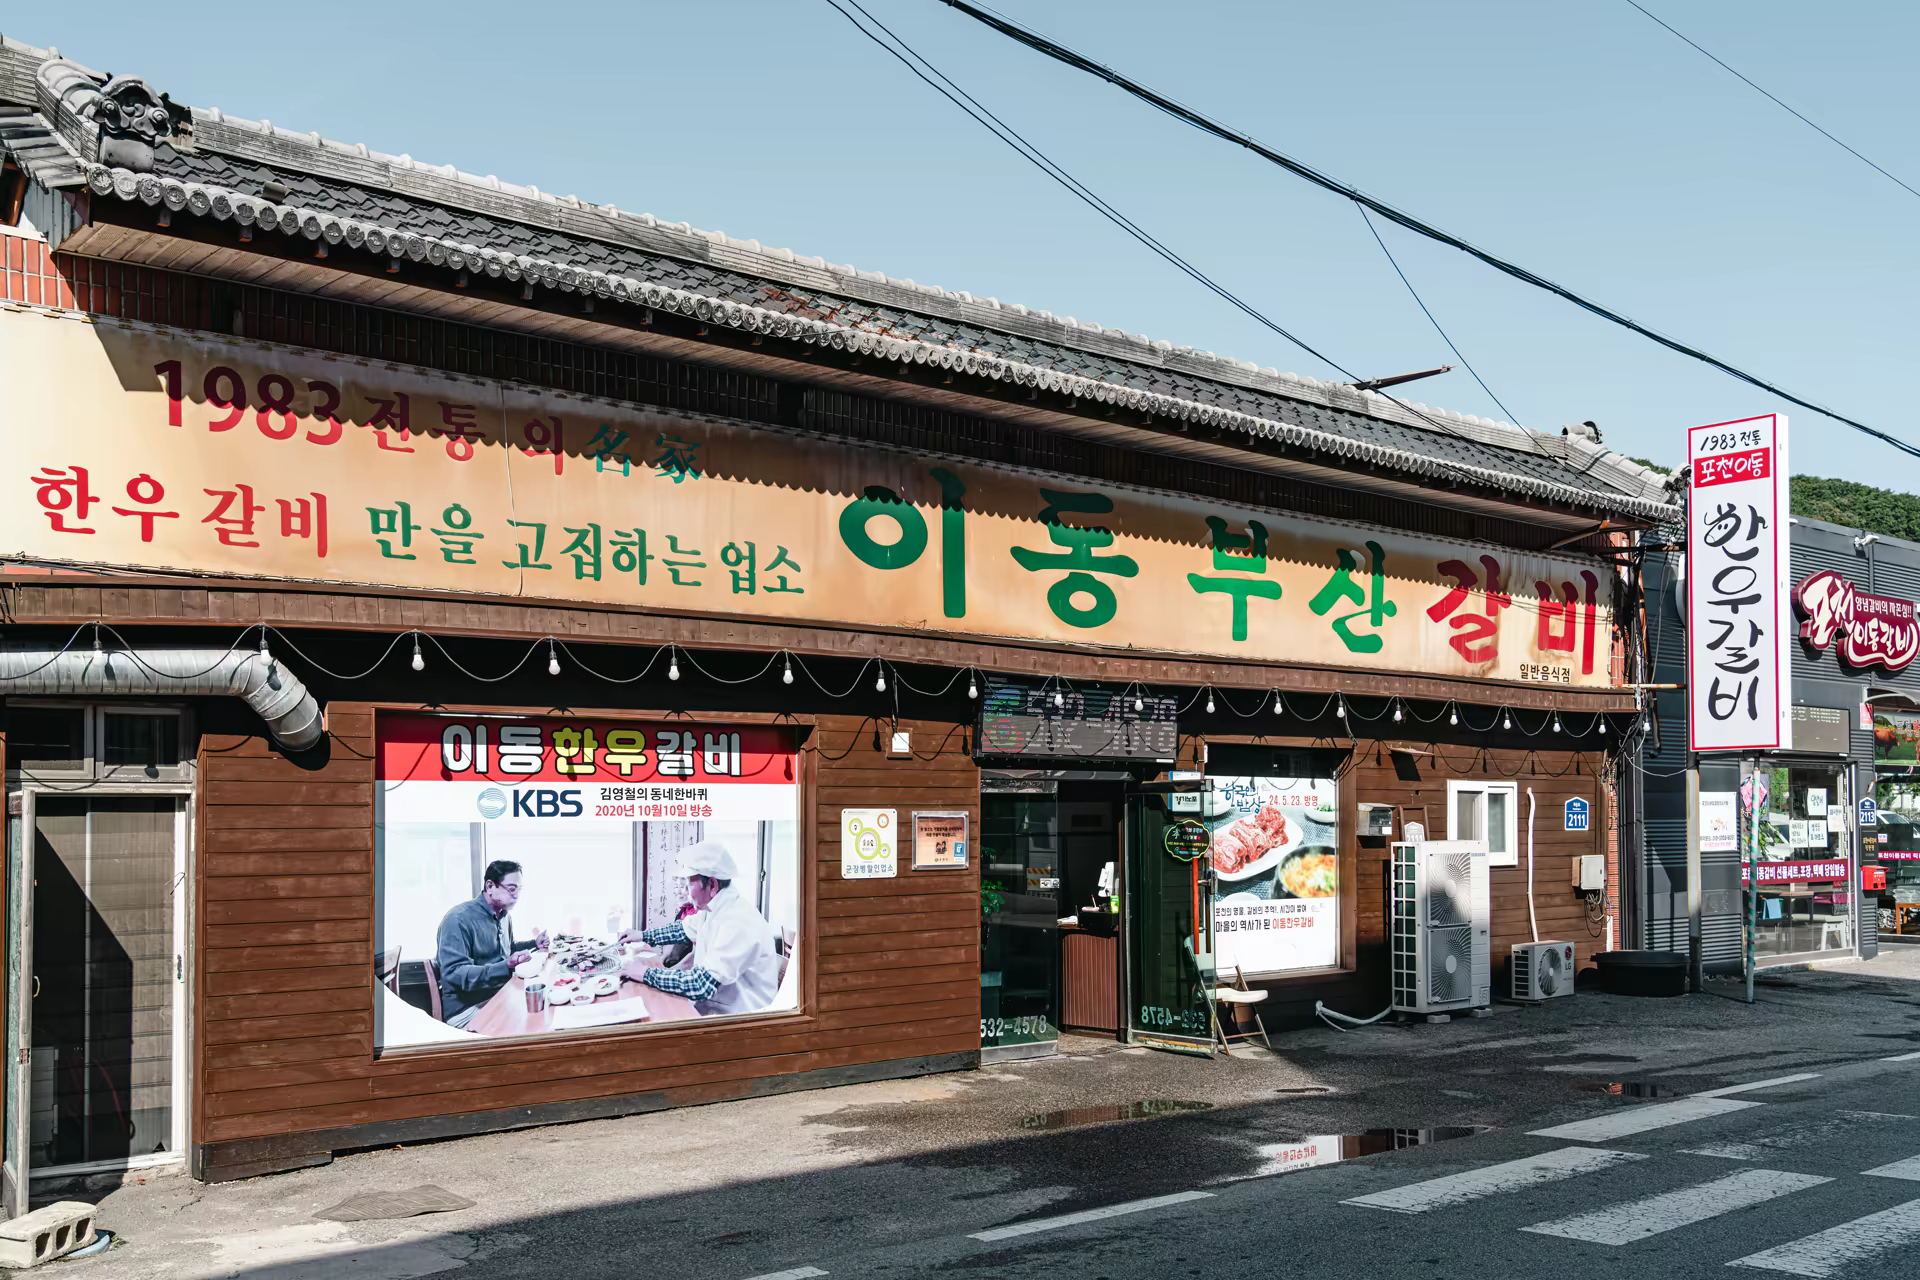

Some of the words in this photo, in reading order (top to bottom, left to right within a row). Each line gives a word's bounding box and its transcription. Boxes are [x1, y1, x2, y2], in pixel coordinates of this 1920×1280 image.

[154, 359, 344, 446] 1983
[585, 423, 704, 484] 名家
[1700, 433, 1737, 451] 1983
[1740, 430, 1762, 446] 전통
[1700, 452, 1764, 484] 포천이동
[30, 465, 329, 558] 한우갈비
[364, 500, 486, 565] 만을
[1703, 502, 1769, 721] 한우갈비
[1855, 596, 1889, 615] 양념갈비의
[1889, 602, 1912, 618] 자존심!!
[1853, 617, 1912, 657] 이동갈비
[1519, 663, 1571, 683] 일반음식점
[441, 723, 742, 777] 이동한우갈비
[513, 788, 583, 818] KBS
[600, 787, 648, 801] 김영철의
[650, 787, 708, 801] 동네한바퀴
[1304, 795, 1319, 807] 방영
[595, 804, 635, 817] 2020년
[690, 804, 713, 817] 방송
[1860, 811, 1875, 823] 2113
[1568, 813, 1585, 827] 2111
[845, 863, 894, 875] 군장병할인업소
[1824, 863, 1846, 877] 당일발송
[1247, 905, 1264, 915] 갈비의
[1215, 920, 1238, 932] 마을의
[1239, 919, 1262, 931] 역사가
[1263, 918, 1271, 930] 된
[1272, 916, 1314, 930] 이동한우갈비
[1565, 962, 1572, 971] LG
